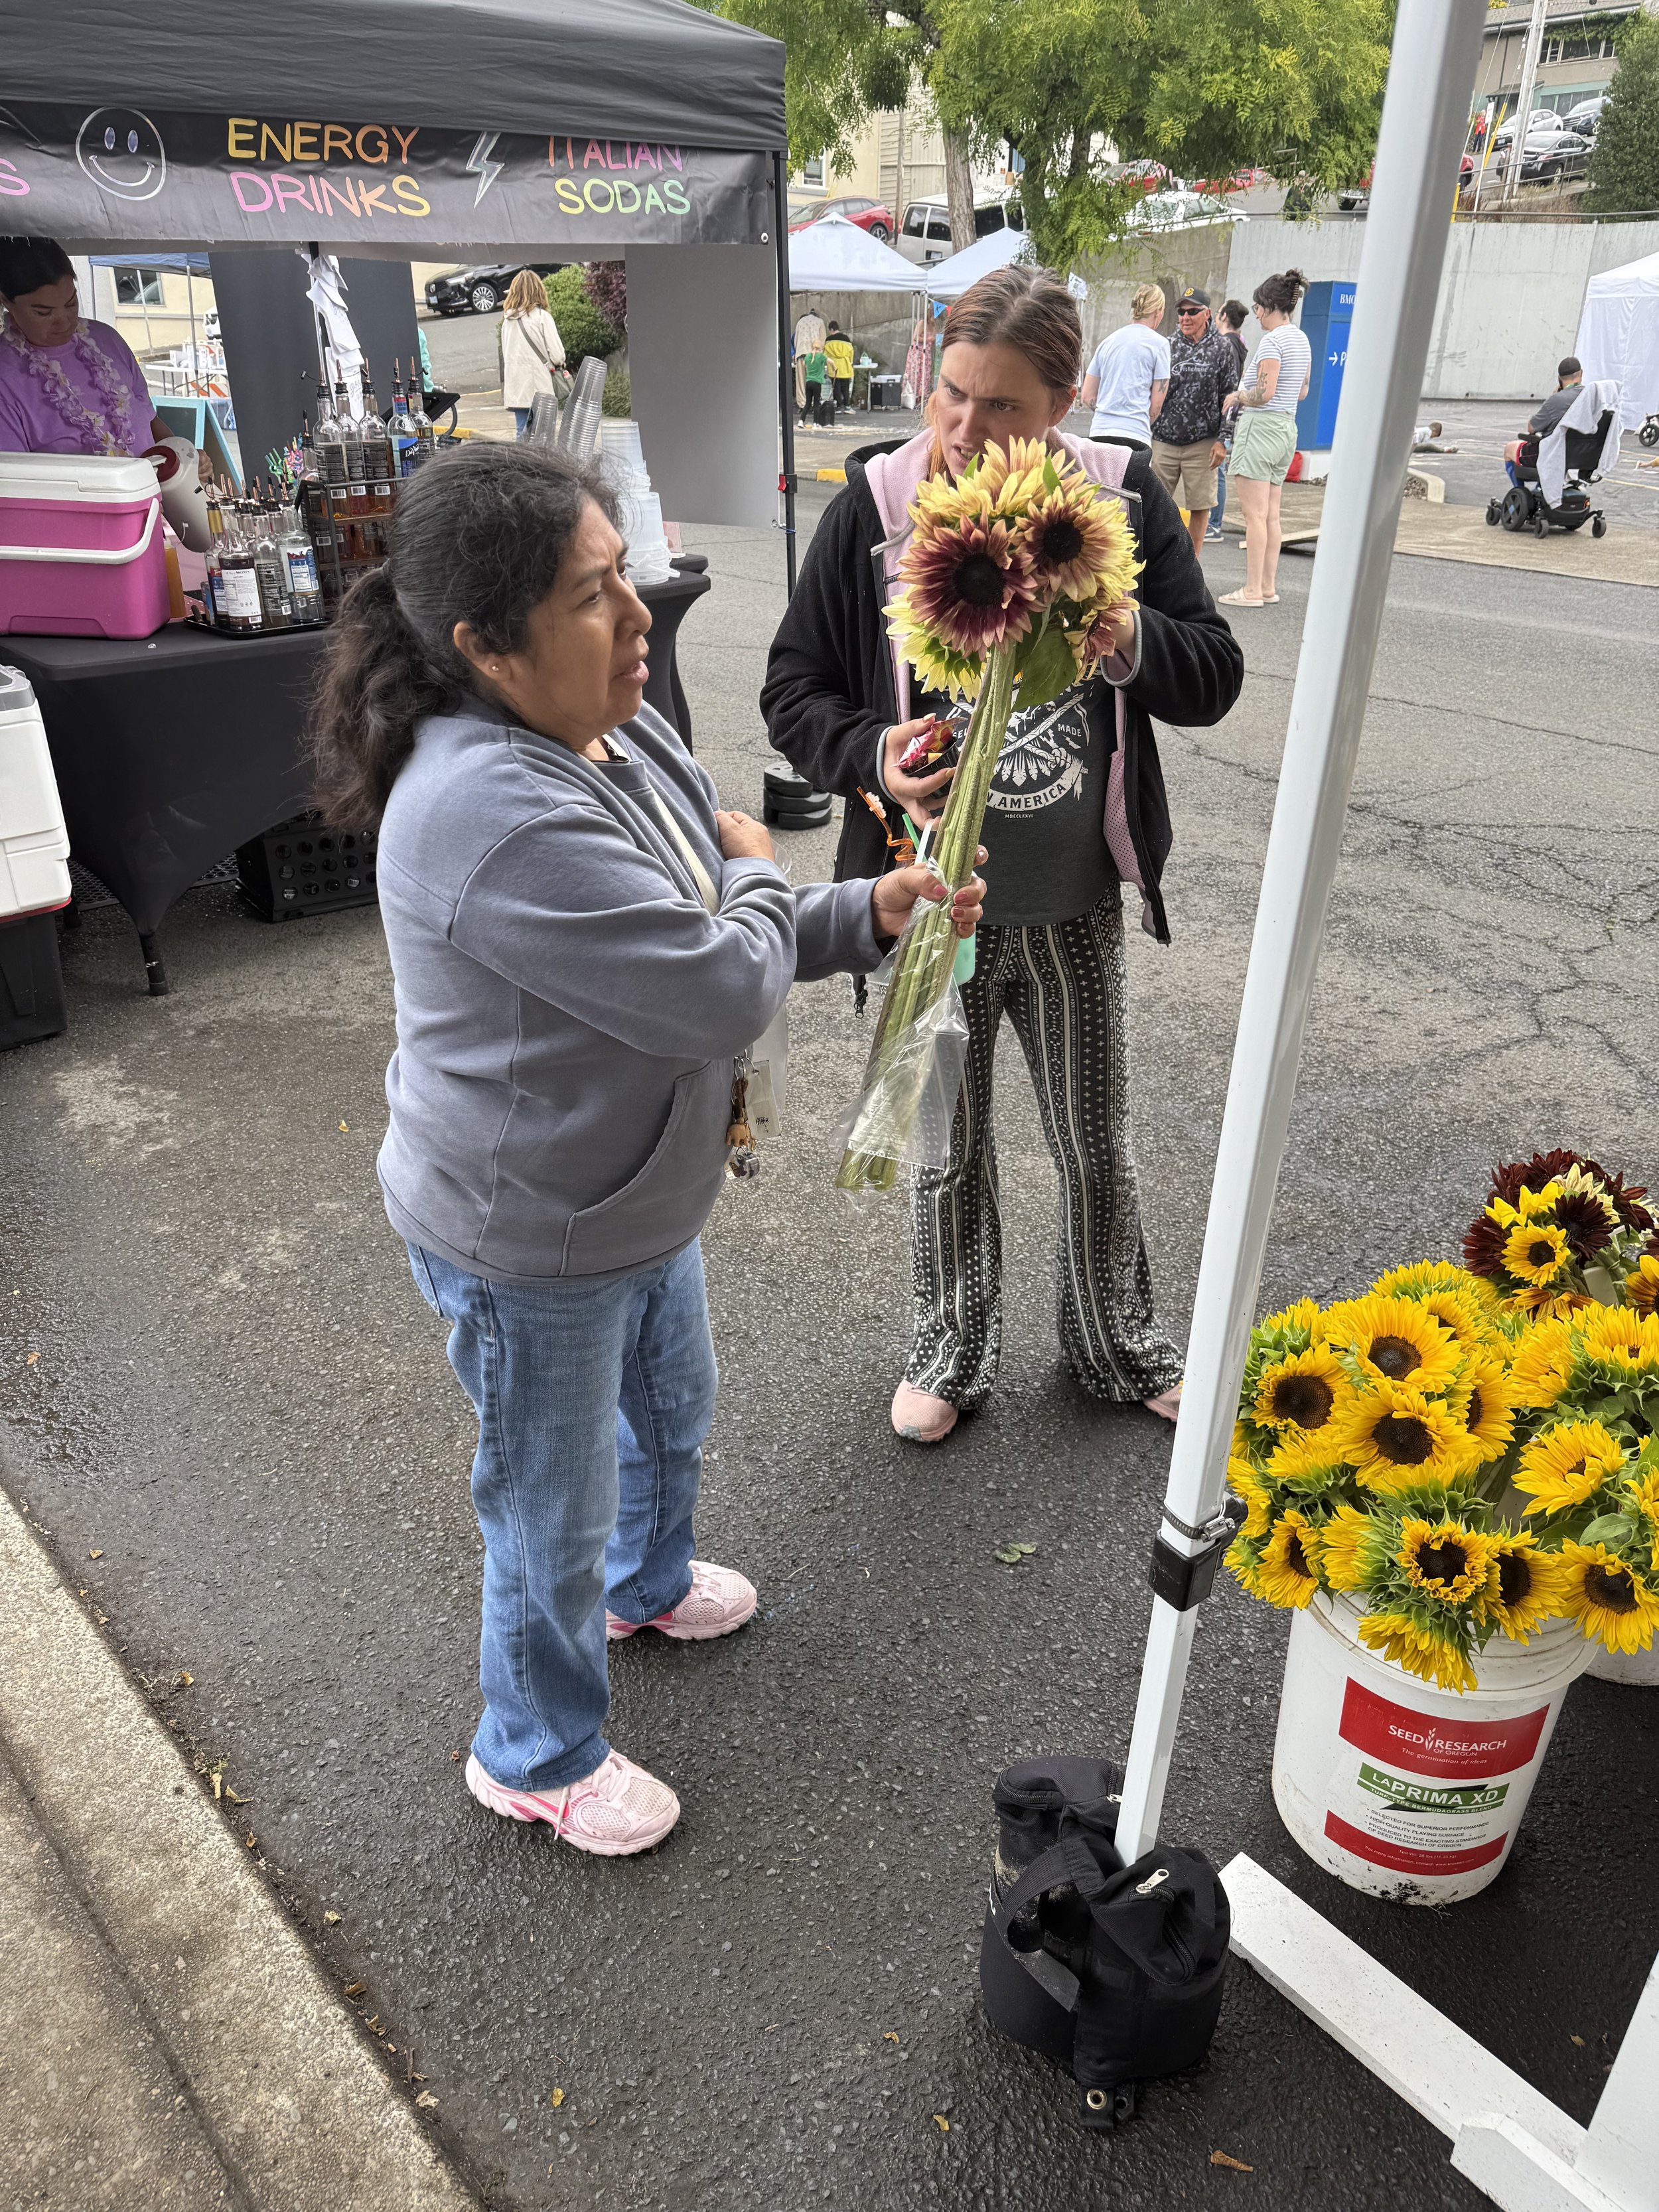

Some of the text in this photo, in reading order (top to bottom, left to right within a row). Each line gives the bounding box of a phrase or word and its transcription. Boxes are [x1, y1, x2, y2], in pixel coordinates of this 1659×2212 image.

[228, 117, 419, 165] ENERGY
[229, 171, 431, 218] DRINKS
[554, 177, 691, 215] SODAS
[1340, 293, 1356, 305] BMO
[1058, 723, 1082, 737] MADE
[997, 783, 1066, 808] AMERICA
[1388, 1725, 1507, 1751] SEED RESEARCH
[1402, 1747, 1415, 1756] The
[1416, 1753, 1459, 1765] germination
[1372, 1773, 1499, 1805] LAPRIMA XD
[1370, 1788, 1410, 1808] TURF-TYPE
[1411, 1804, 1470, 1814] BERMUDAGRASS
[1370, 1816, 1384, 1824] HIGH
[1386, 1822, 1411, 1832] QUALITY
[1371, 1810, 1402, 1823] SELECTED
[1449, 1822, 1490, 1831] PERFORMANCE
[1369, 1822, 1402, 1836] PRODUCED
[1455, 1834, 1486, 1843] STANDARDS
[1377, 1830, 1393, 1839] SEED
[1394, 1836, 1427, 1846] RESEARCH
